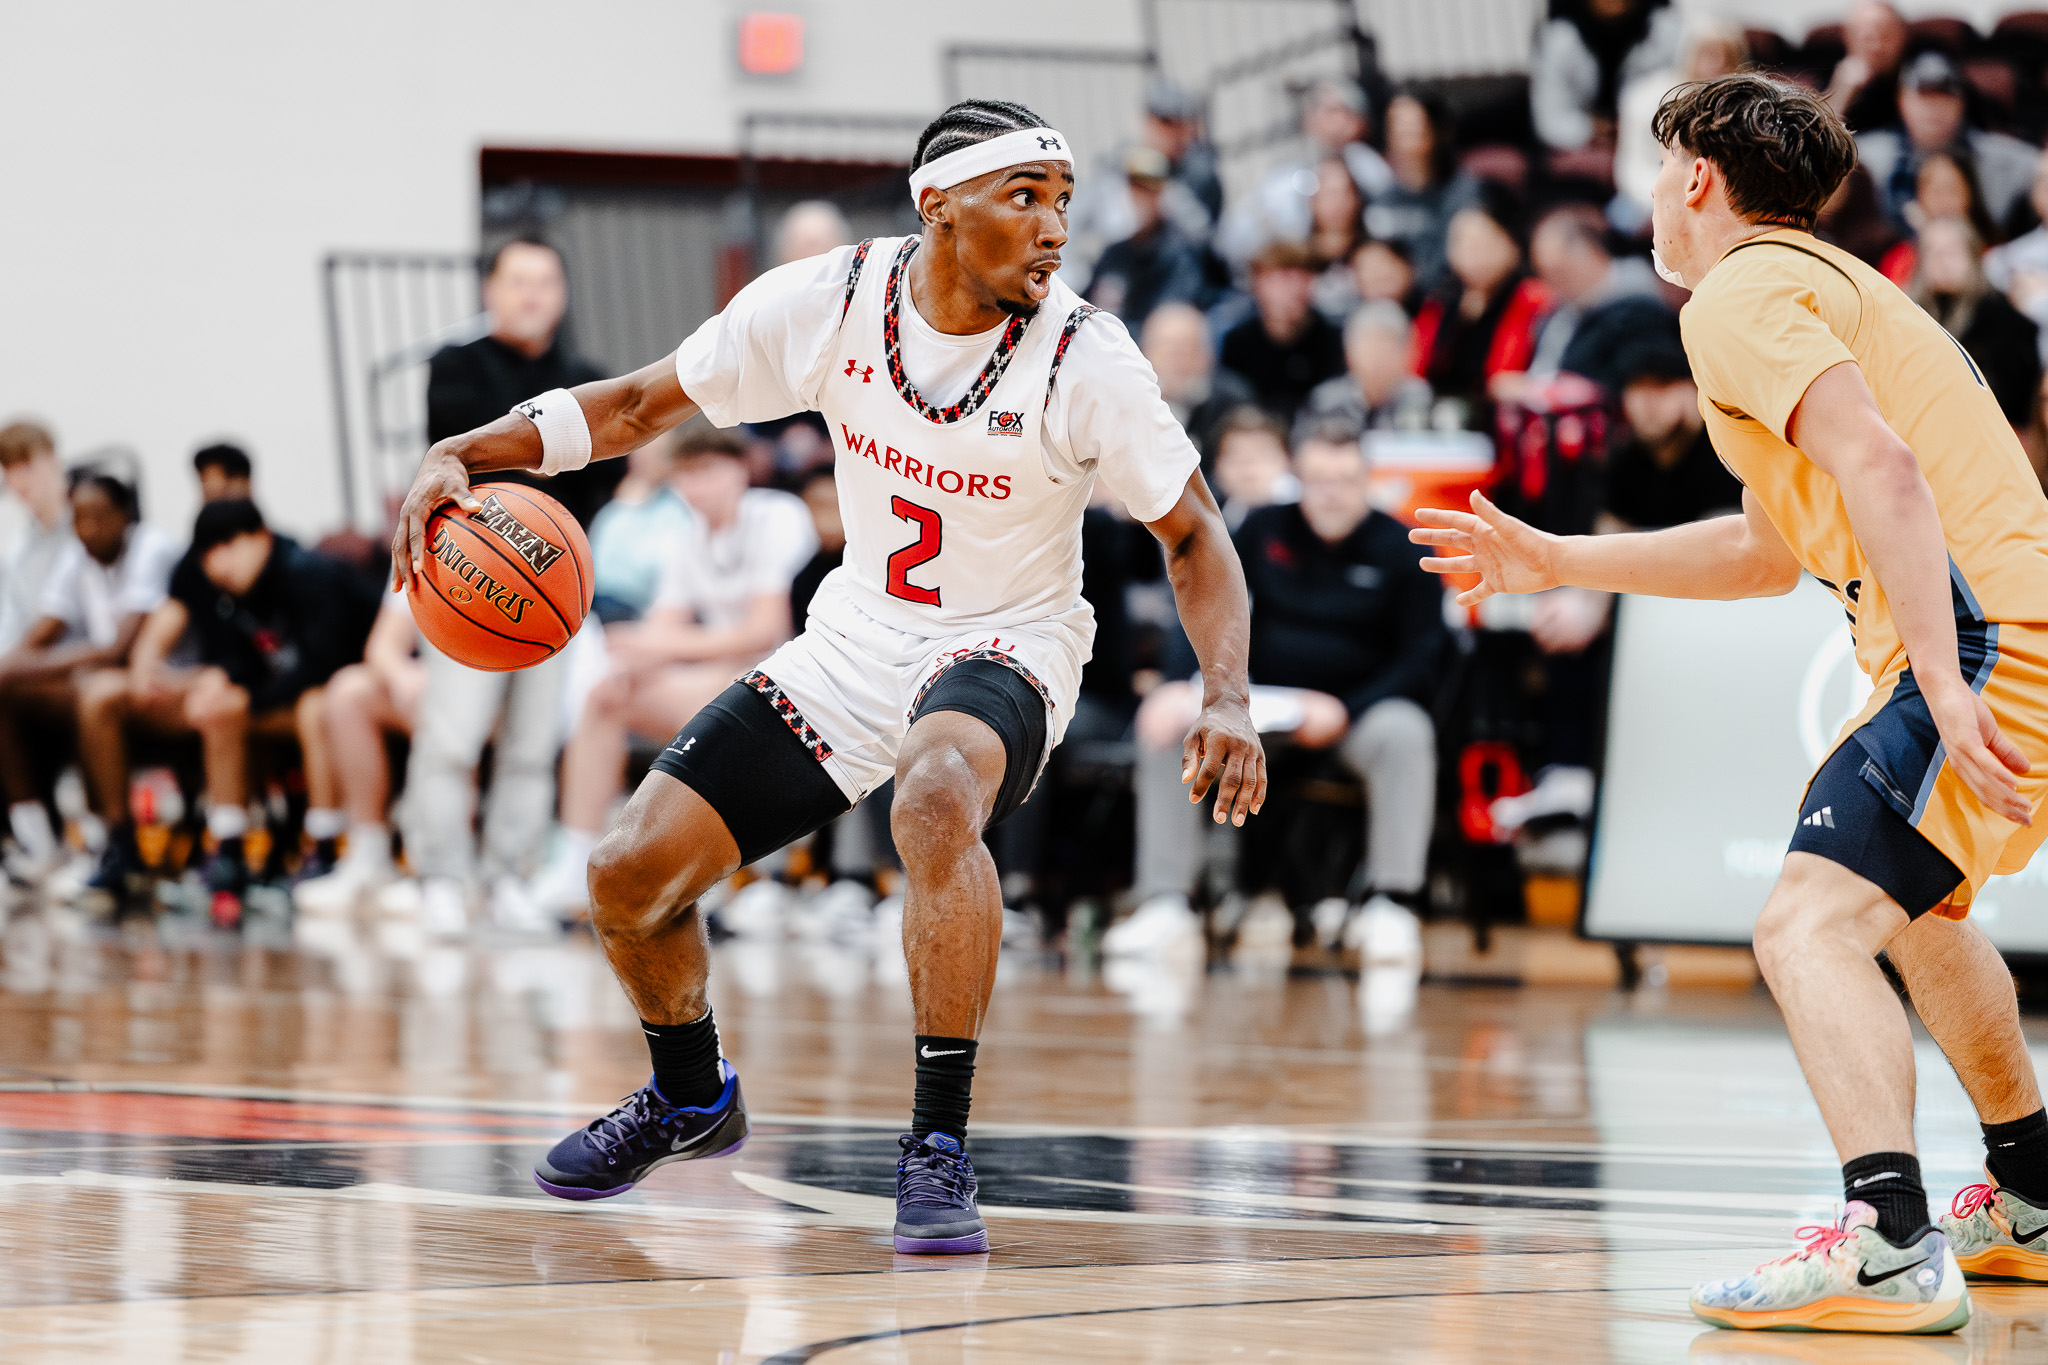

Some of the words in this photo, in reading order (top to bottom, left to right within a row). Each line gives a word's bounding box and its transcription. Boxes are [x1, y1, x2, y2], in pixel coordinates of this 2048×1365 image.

[988, 411, 1024, 429] FOX
[841, 423, 1011, 500] WARRIORS
[471, 495, 562, 574] NAIA
[886, 495, 942, 608] 2
[427, 527, 535, 624] SPALDING
